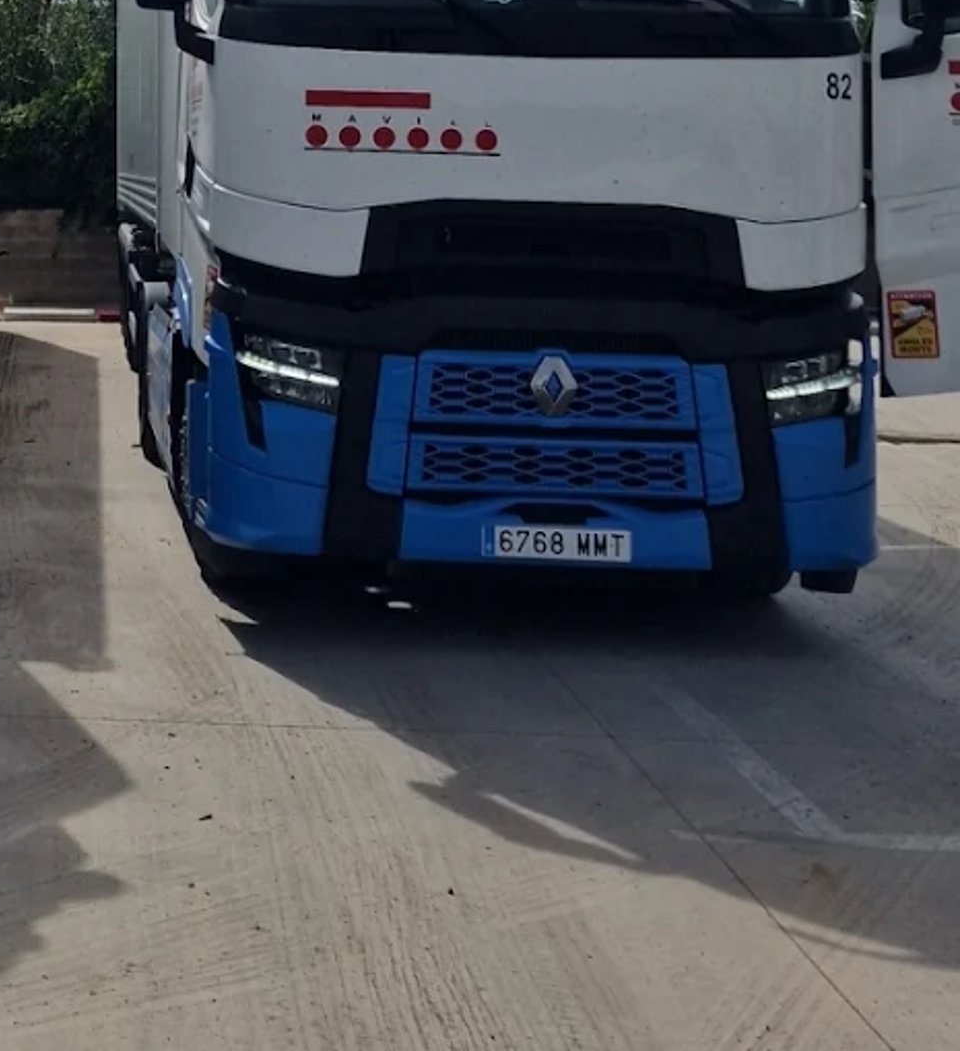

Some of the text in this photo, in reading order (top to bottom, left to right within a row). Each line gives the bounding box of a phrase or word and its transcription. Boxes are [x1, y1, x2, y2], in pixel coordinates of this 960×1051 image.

[827, 73, 852, 99] 82
[499, 530, 624, 556] 6768 MMT
